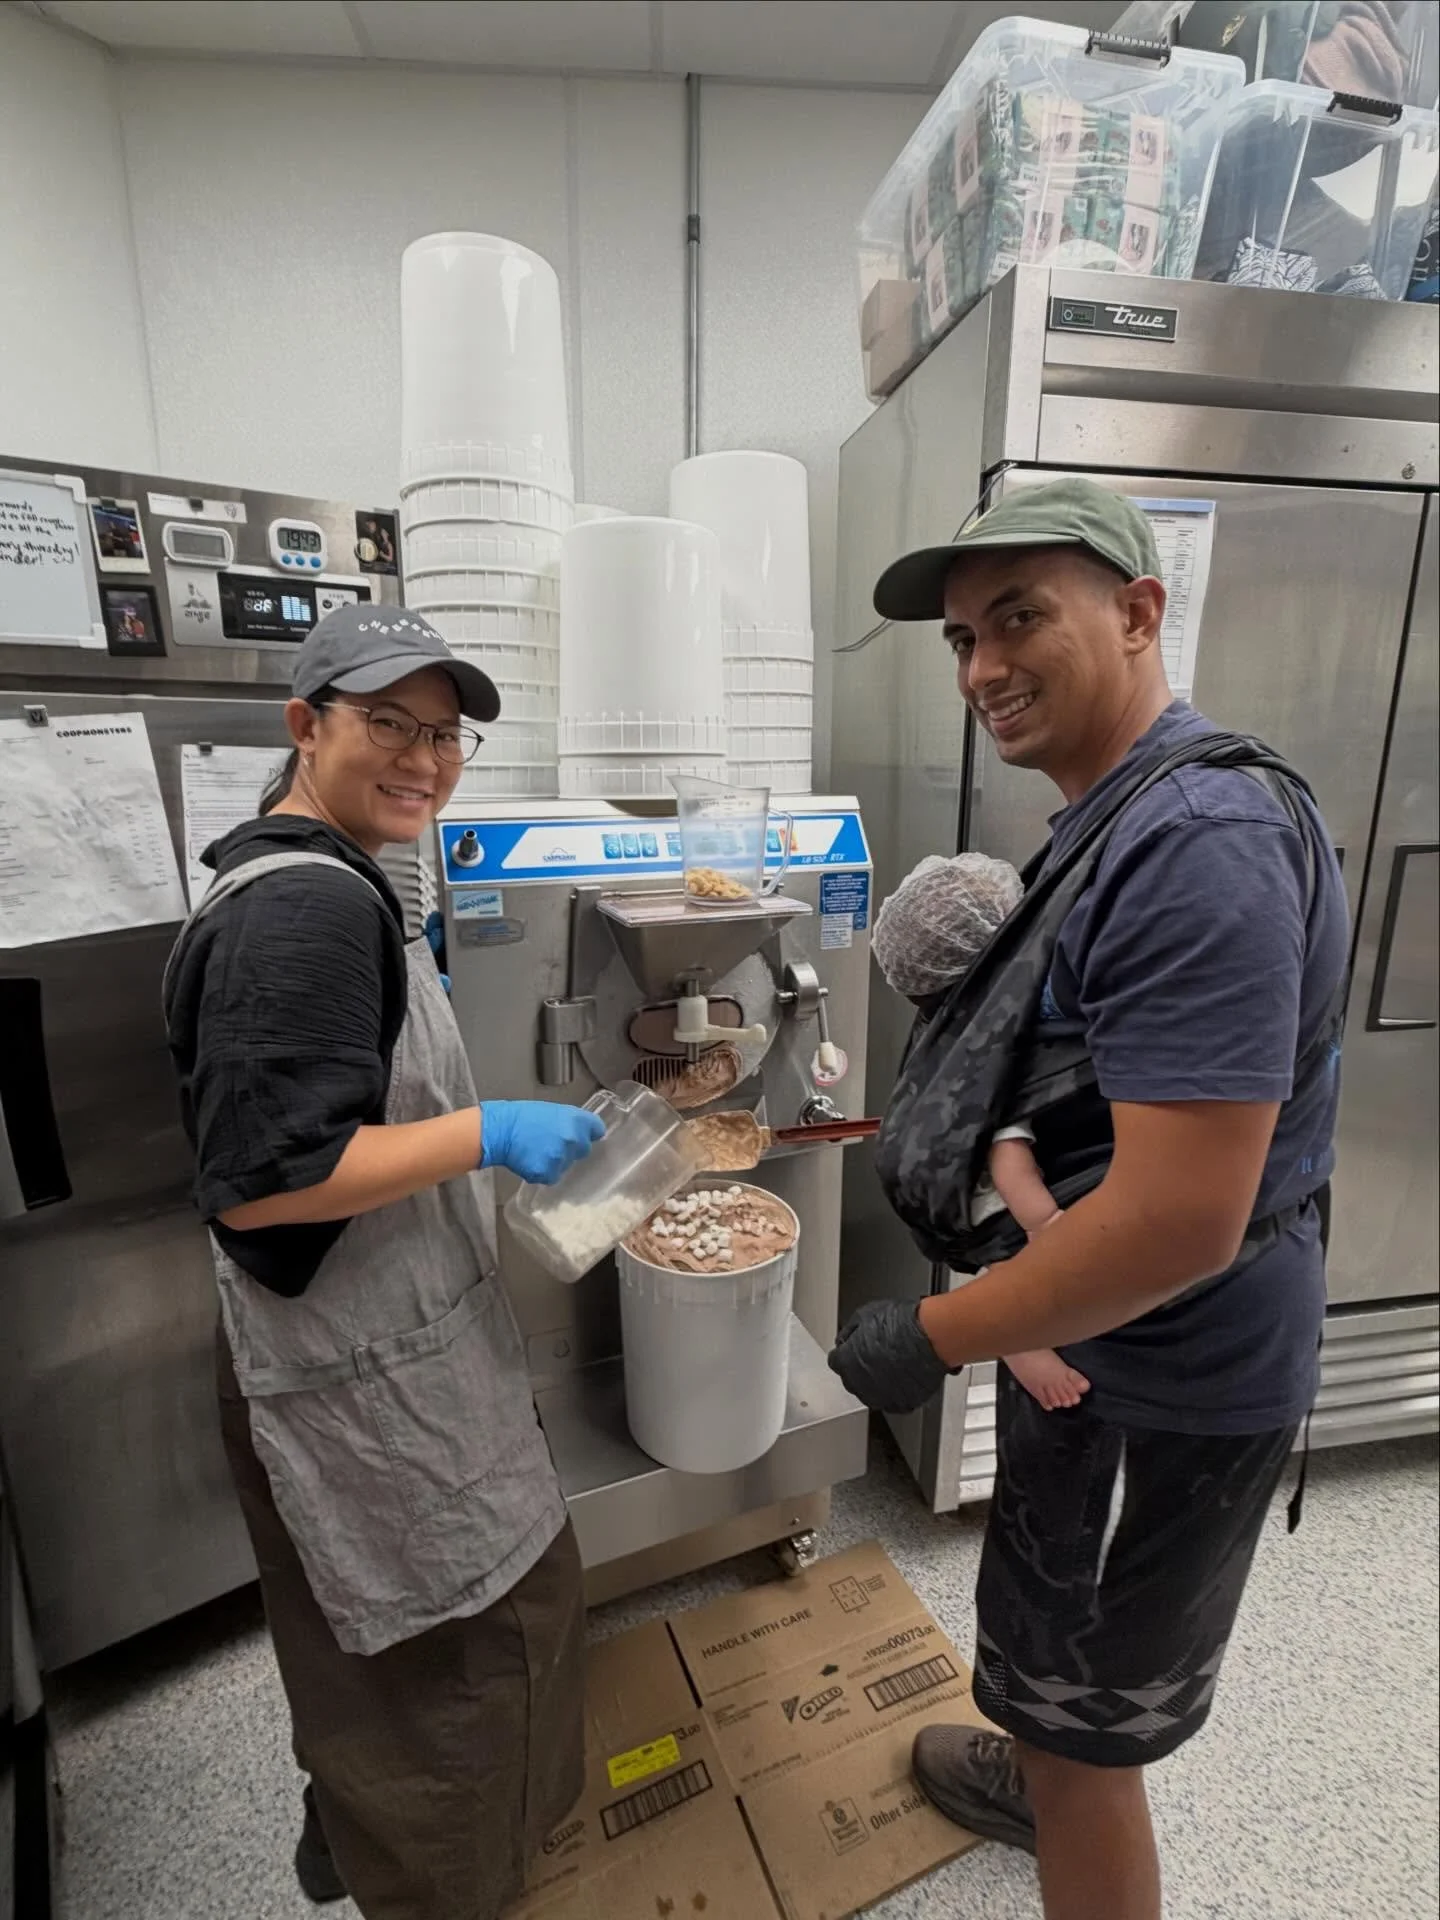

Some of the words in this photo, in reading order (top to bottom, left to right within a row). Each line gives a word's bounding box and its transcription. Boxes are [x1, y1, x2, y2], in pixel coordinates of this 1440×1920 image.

[702, 1631, 750, 1660] HANDLE
[750, 1620, 781, 1640] WITH
[781, 1608, 813, 1629] CARE
[870, 1806, 902, 1831] Other
